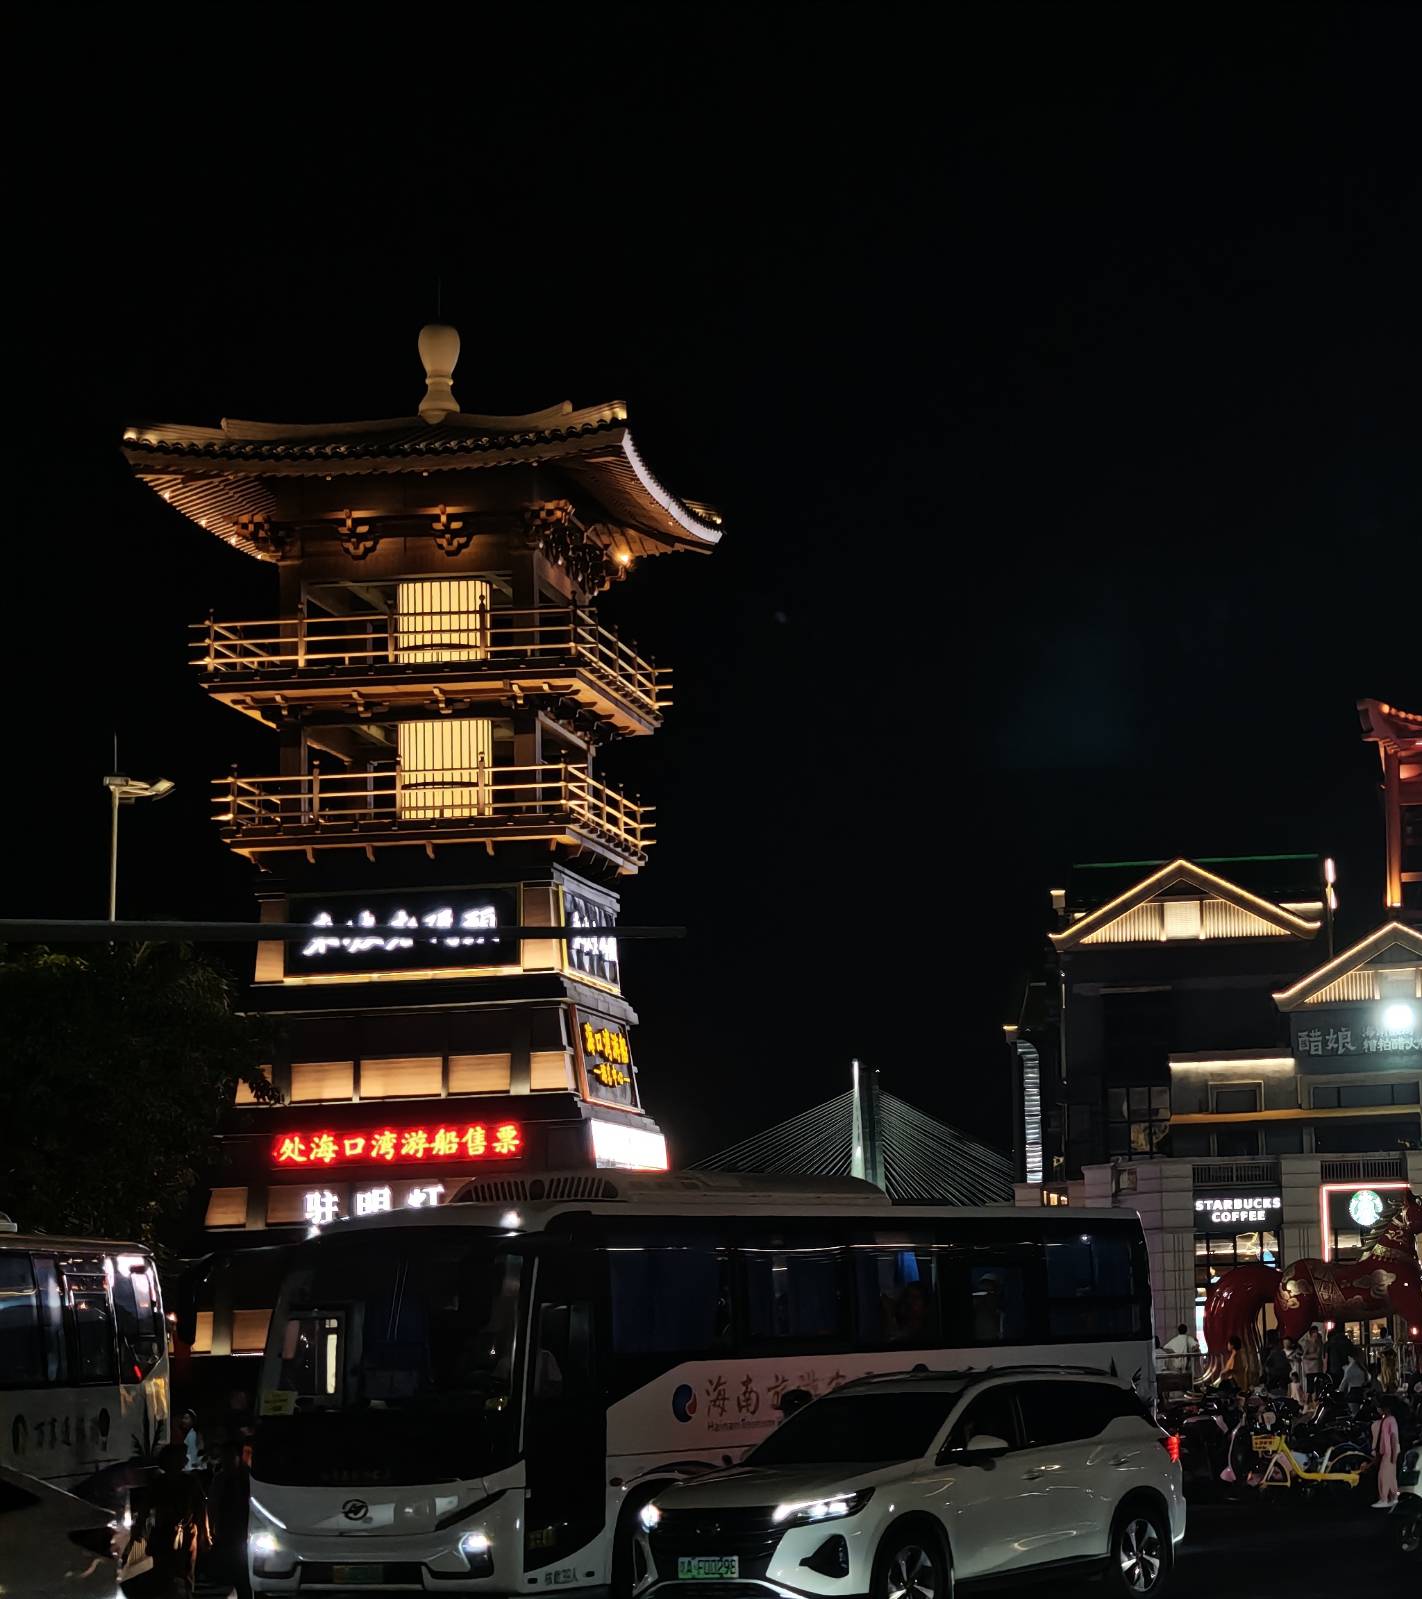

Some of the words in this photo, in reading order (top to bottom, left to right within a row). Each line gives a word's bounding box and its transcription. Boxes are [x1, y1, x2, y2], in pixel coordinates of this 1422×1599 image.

[1298, 1027, 1356, 1055] 醋娘
[278, 1124, 521, 1164] 处海口湾游船售票
[1195, 1197, 1281, 1211] STARBUCKS
[1211, 1210, 1266, 1223] COFFEE
